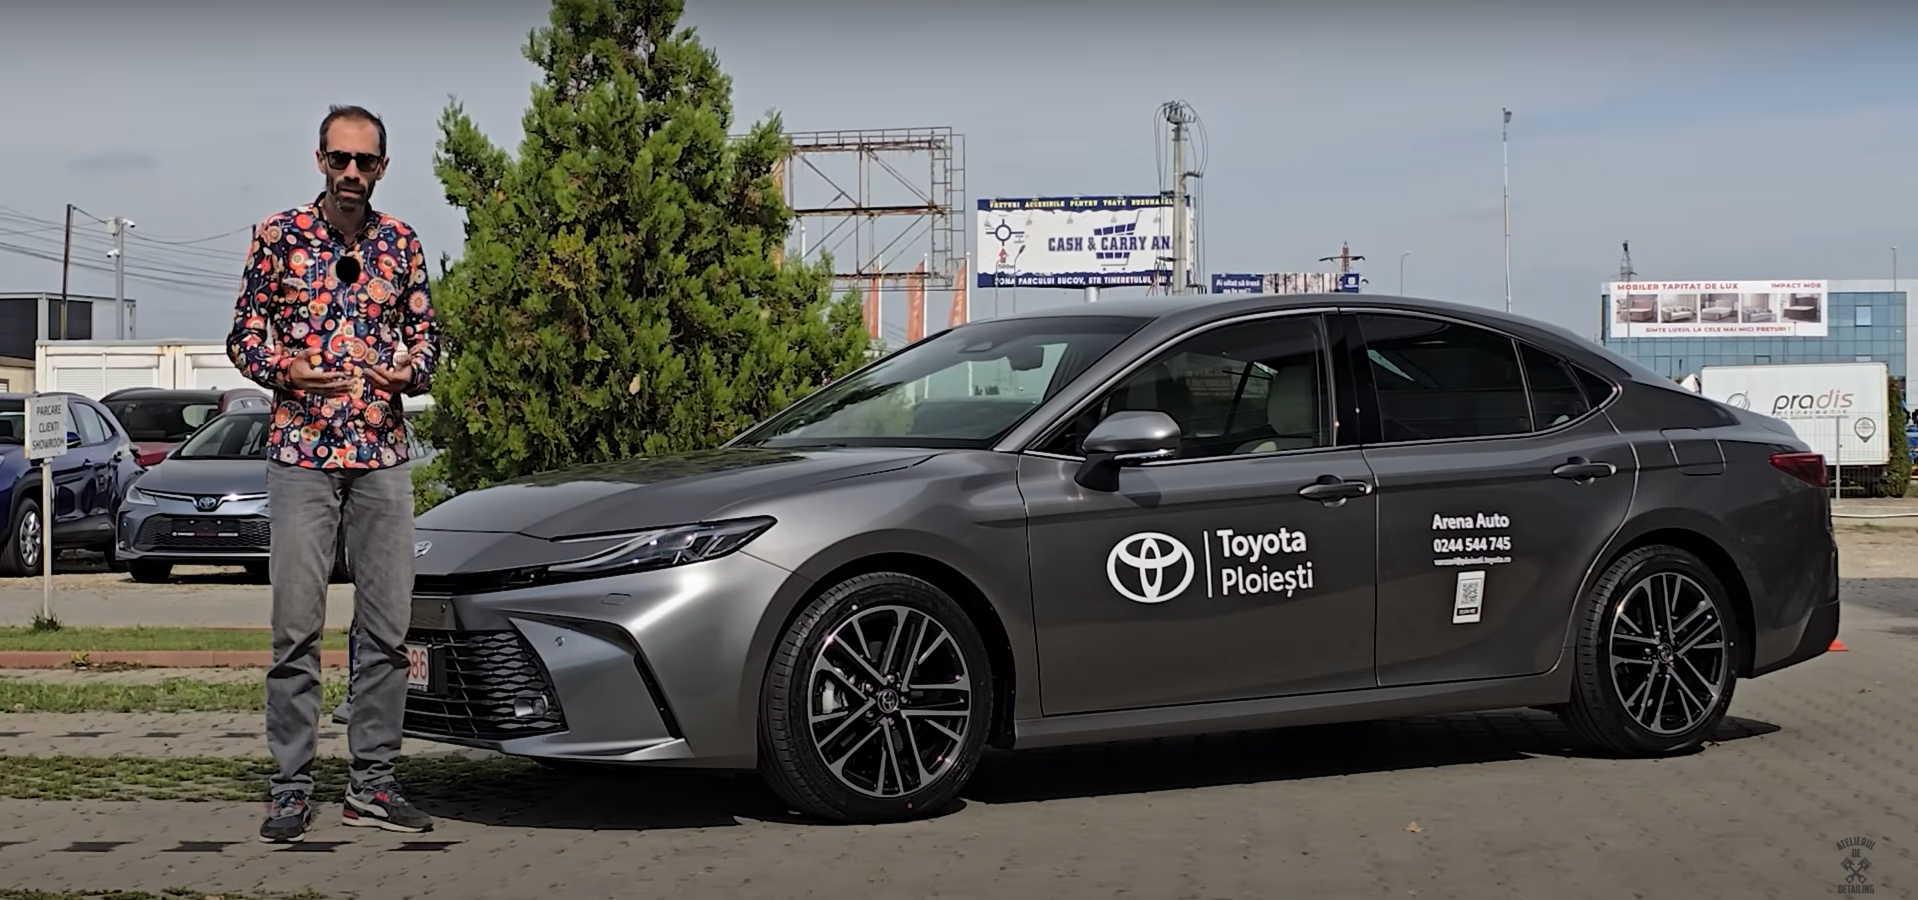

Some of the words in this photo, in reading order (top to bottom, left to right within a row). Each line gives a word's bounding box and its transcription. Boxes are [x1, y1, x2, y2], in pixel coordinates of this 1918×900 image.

[1048, 237, 1083, 251] CASH
[1087, 237, 1097, 251] &
[1101, 236, 1147, 250] CARRY
[1151, 236, 1173, 250] AN
[1018, 277, 1055, 285] PARCULUI
[36, 404, 62, 416] PARCARE
[1772, 389, 1854, 414] pradis
[32, 437, 65, 451] SHOWROOM
[1432, 513, 1474, 530] Arena
[1476, 512, 1510, 528] Auto
[1216, 527, 1307, 563] Toyota
[1433, 538, 1464, 553] 0244
[1465, 537, 1488, 551] 544
[1489, 536, 1511, 551] 745
[1221, 561, 1313, 598] Ploiești
